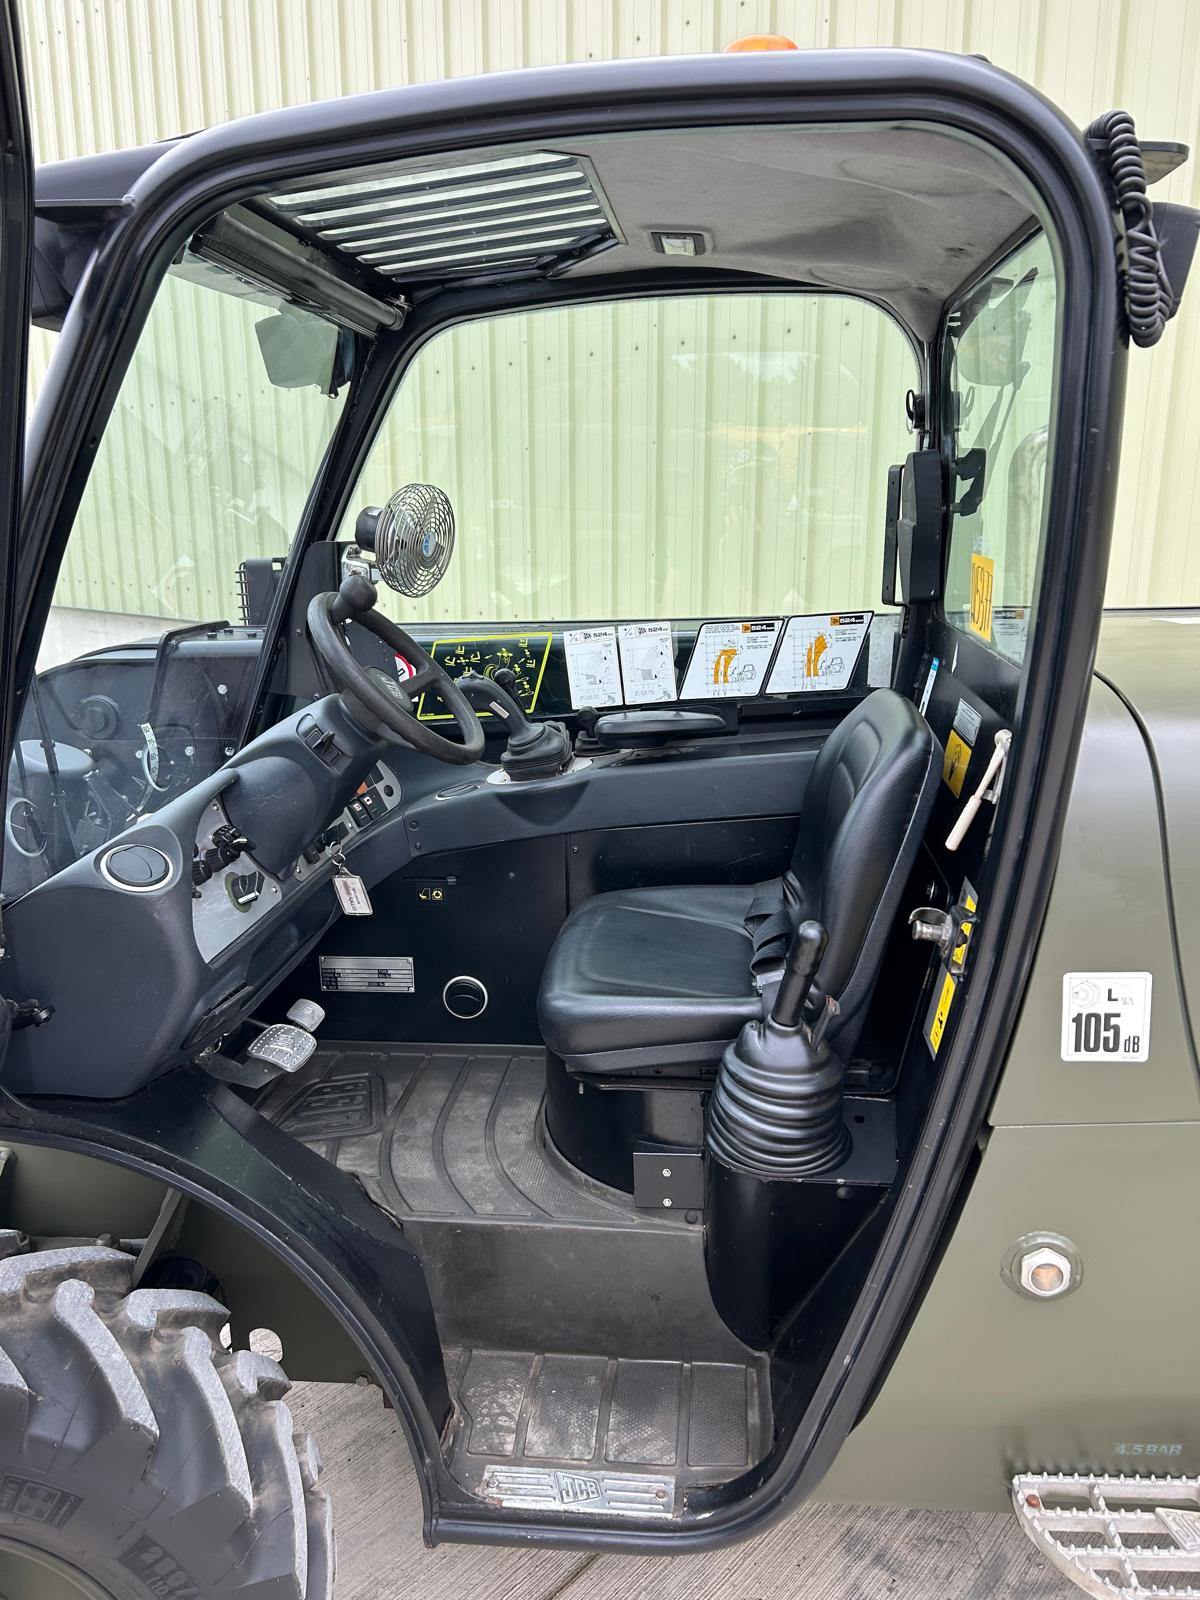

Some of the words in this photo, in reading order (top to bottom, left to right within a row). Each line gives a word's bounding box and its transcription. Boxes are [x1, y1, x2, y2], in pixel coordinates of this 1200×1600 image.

[1072, 1012, 1121, 1053] 105
[1124, 1035, 1140, 1053] dB
[1145, 1444, 1182, 1456] BAR
[560, 1475, 600, 1502] JCB
